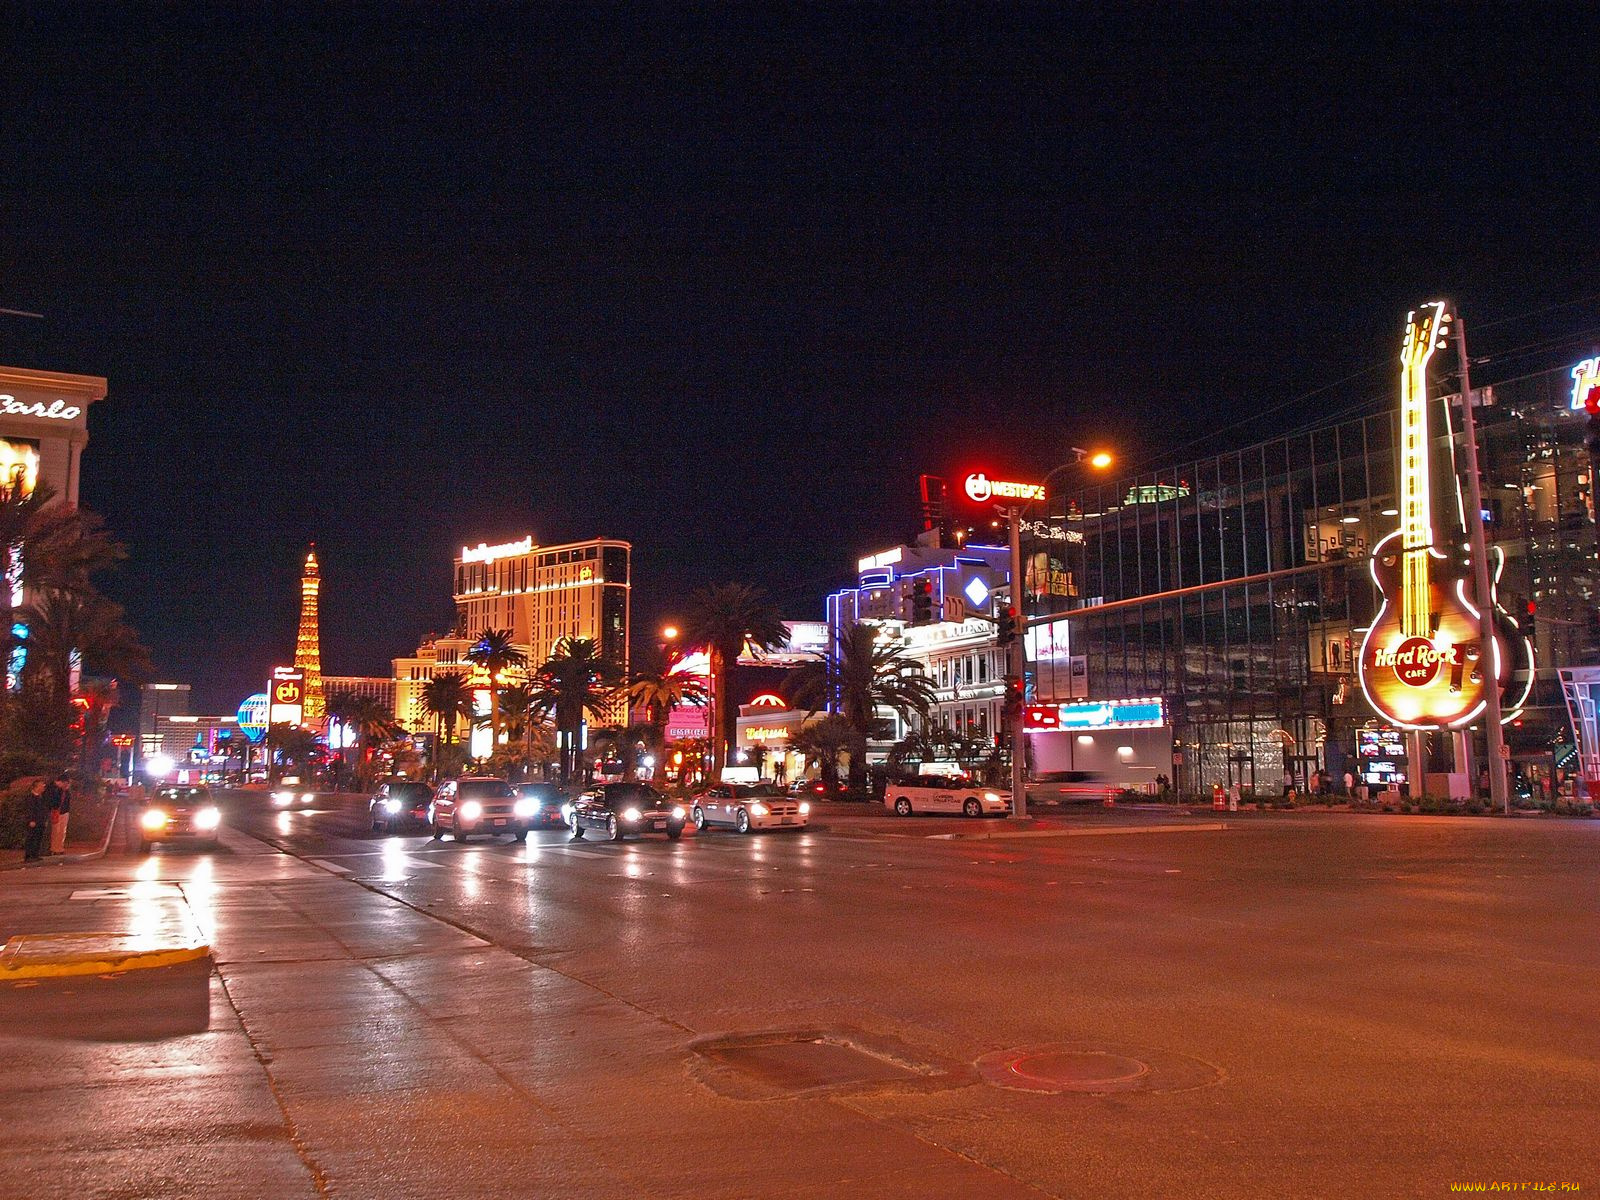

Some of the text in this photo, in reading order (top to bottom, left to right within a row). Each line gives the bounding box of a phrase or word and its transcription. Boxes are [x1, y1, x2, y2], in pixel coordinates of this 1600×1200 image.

[0, 395, 81, 420] Carlo
[1374, 647, 1416, 667] Hard
[1405, 669, 1427, 679] CAFE
[746, 727, 788, 743] Walgreens
